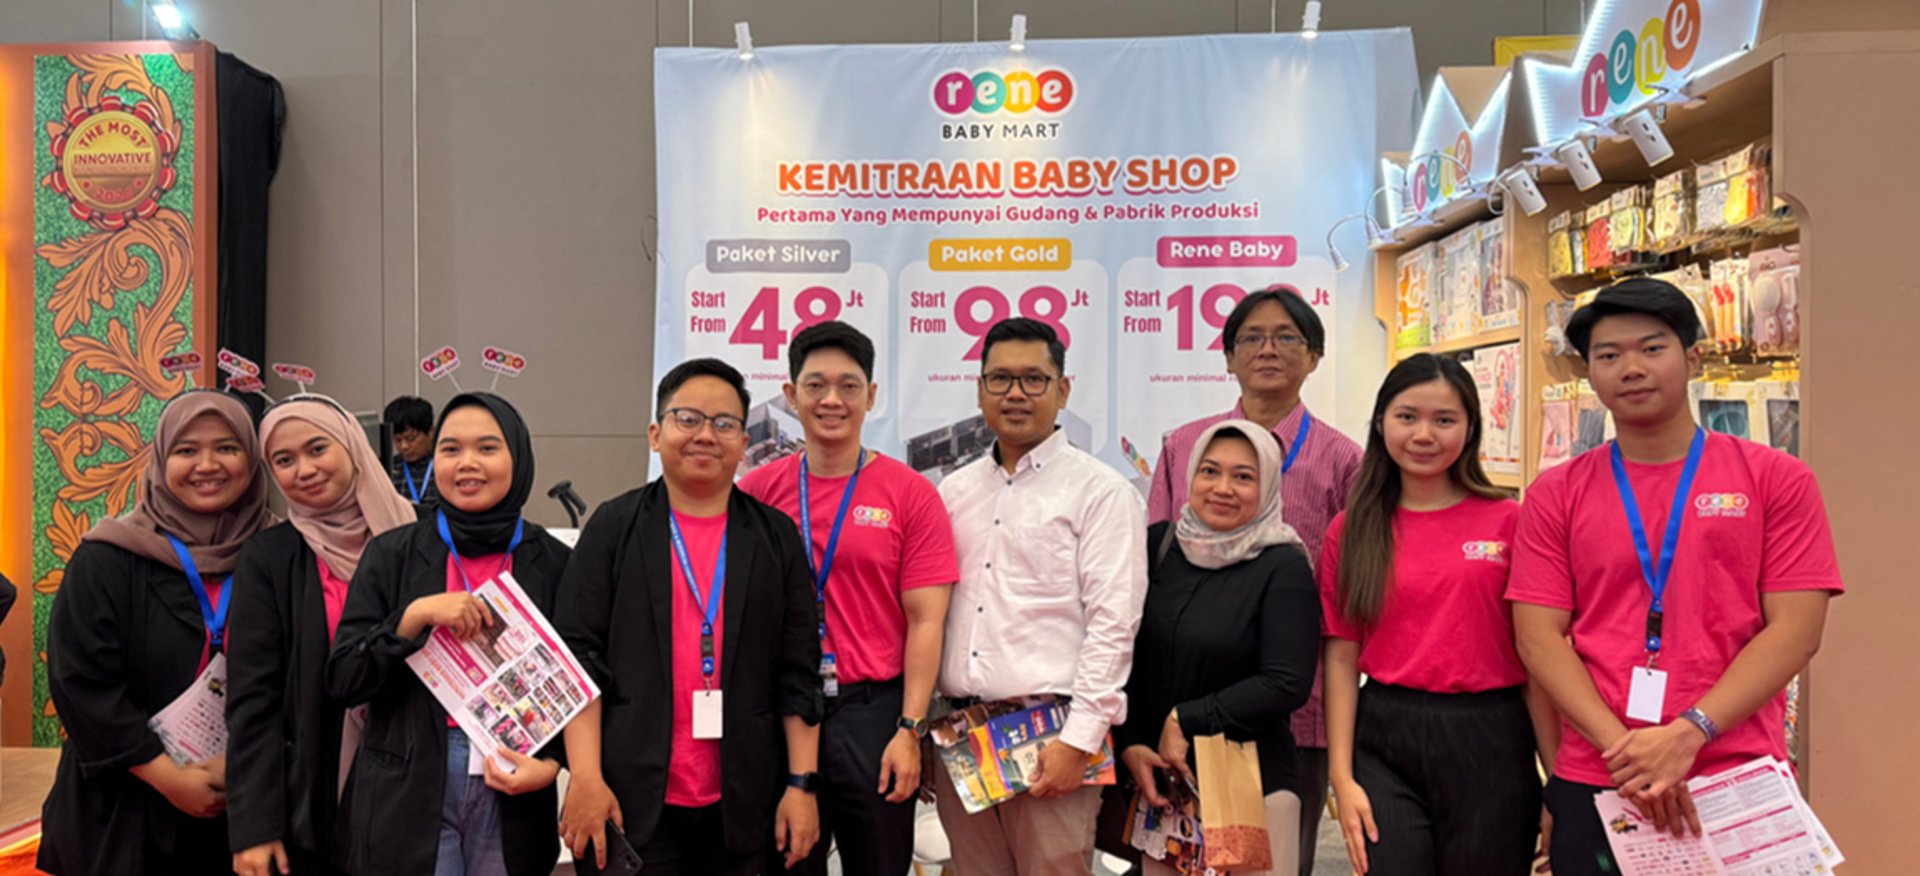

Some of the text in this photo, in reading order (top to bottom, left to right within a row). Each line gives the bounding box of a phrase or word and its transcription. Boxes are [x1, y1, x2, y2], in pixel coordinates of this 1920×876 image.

[1588, 1, 1695, 114] rene
[943, 76, 1066, 109] rene
[79, 121, 147, 148] THE MOST
[942, 123, 1060, 139] BABY MART
[74, 152, 151, 165] INNOVATIVE
[778, 156, 1238, 195] KEMITRAAN BABY SHOP
[1415, 137, 1471, 206] rene
[756, 201, 1259, 227] Pertama Yang Mempunyai Gudang & Pabrik Produksi
[716, 244, 841, 263] Paket Silver
[941, 245, 1059, 263] Paket Gold
[1170, 240, 1284, 260] Rene Baby
[690, 290, 726, 308] Start
[845, 289, 865, 307] Jt
[910, 290, 946, 308] Start
[1071, 288, 1090, 306] Jt
[1124, 289, 1161, 307] Start
[1310, 287, 1330, 305] Jt
[690, 316, 726, 333] From
[728, 285, 843, 361] 48
[910, 316, 946, 333] From
[953, 285, 1072, 361] 98
[1124, 315, 1162, 333] From
[1166, 282, 1303, 351] 19
[927, 372, 962, 383] ukuran
[1149, 372, 1185, 383] ukuran
[1186, 372, 1227, 383] minimal
